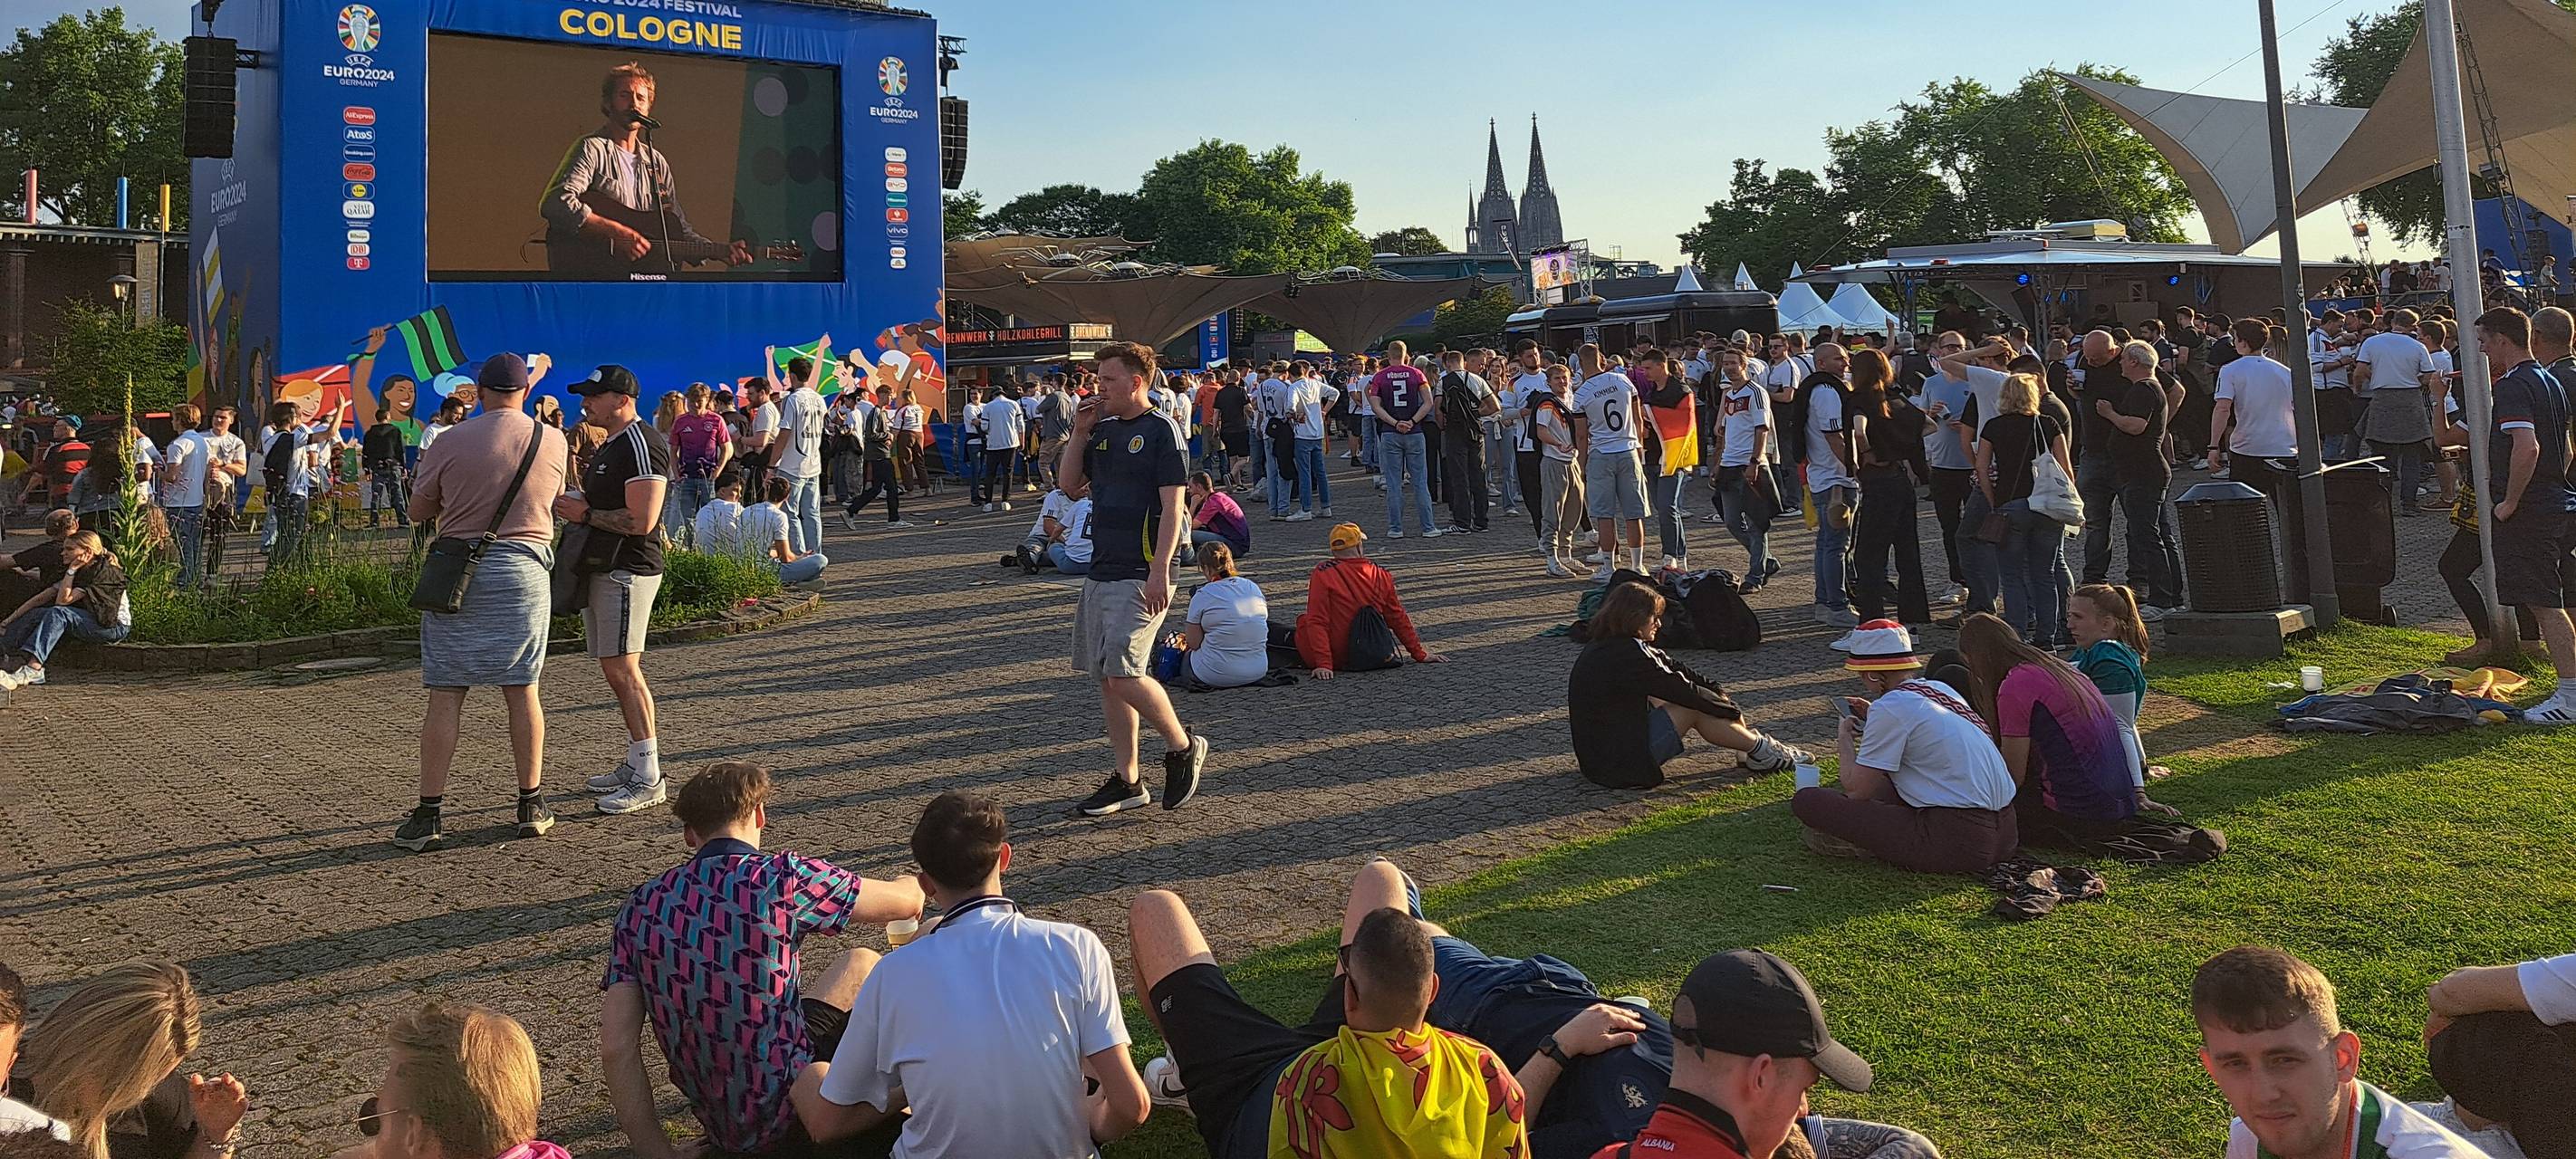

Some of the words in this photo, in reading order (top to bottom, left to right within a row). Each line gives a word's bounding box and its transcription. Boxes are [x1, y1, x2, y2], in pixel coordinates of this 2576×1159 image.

[664, 0, 743, 18] FESTIVAL
[559, 8, 742, 50] COLOGNE
[346, 55, 371, 66] UEFA
[323, 64, 395, 81] EURO2024
[339, 78, 379, 88] GERMANY
[884, 99, 903, 107] UEFA
[870, 106, 918, 120] EURO2024
[210, 179, 247, 214] EURO2024
[353, 258, 363, 268] T
[630, 273, 668, 281] Hisense
[945, 330, 988, 343] RENNWERK
[996, 326, 1062, 341] HOLZKOHLEGRILL
[1392, 380, 1408, 407] 2
[1594, 385, 1619, 399] KIMMICH
[1603, 398, 1623, 432] 6
[1640, 1137, 1675, 1152] ALBANIA
